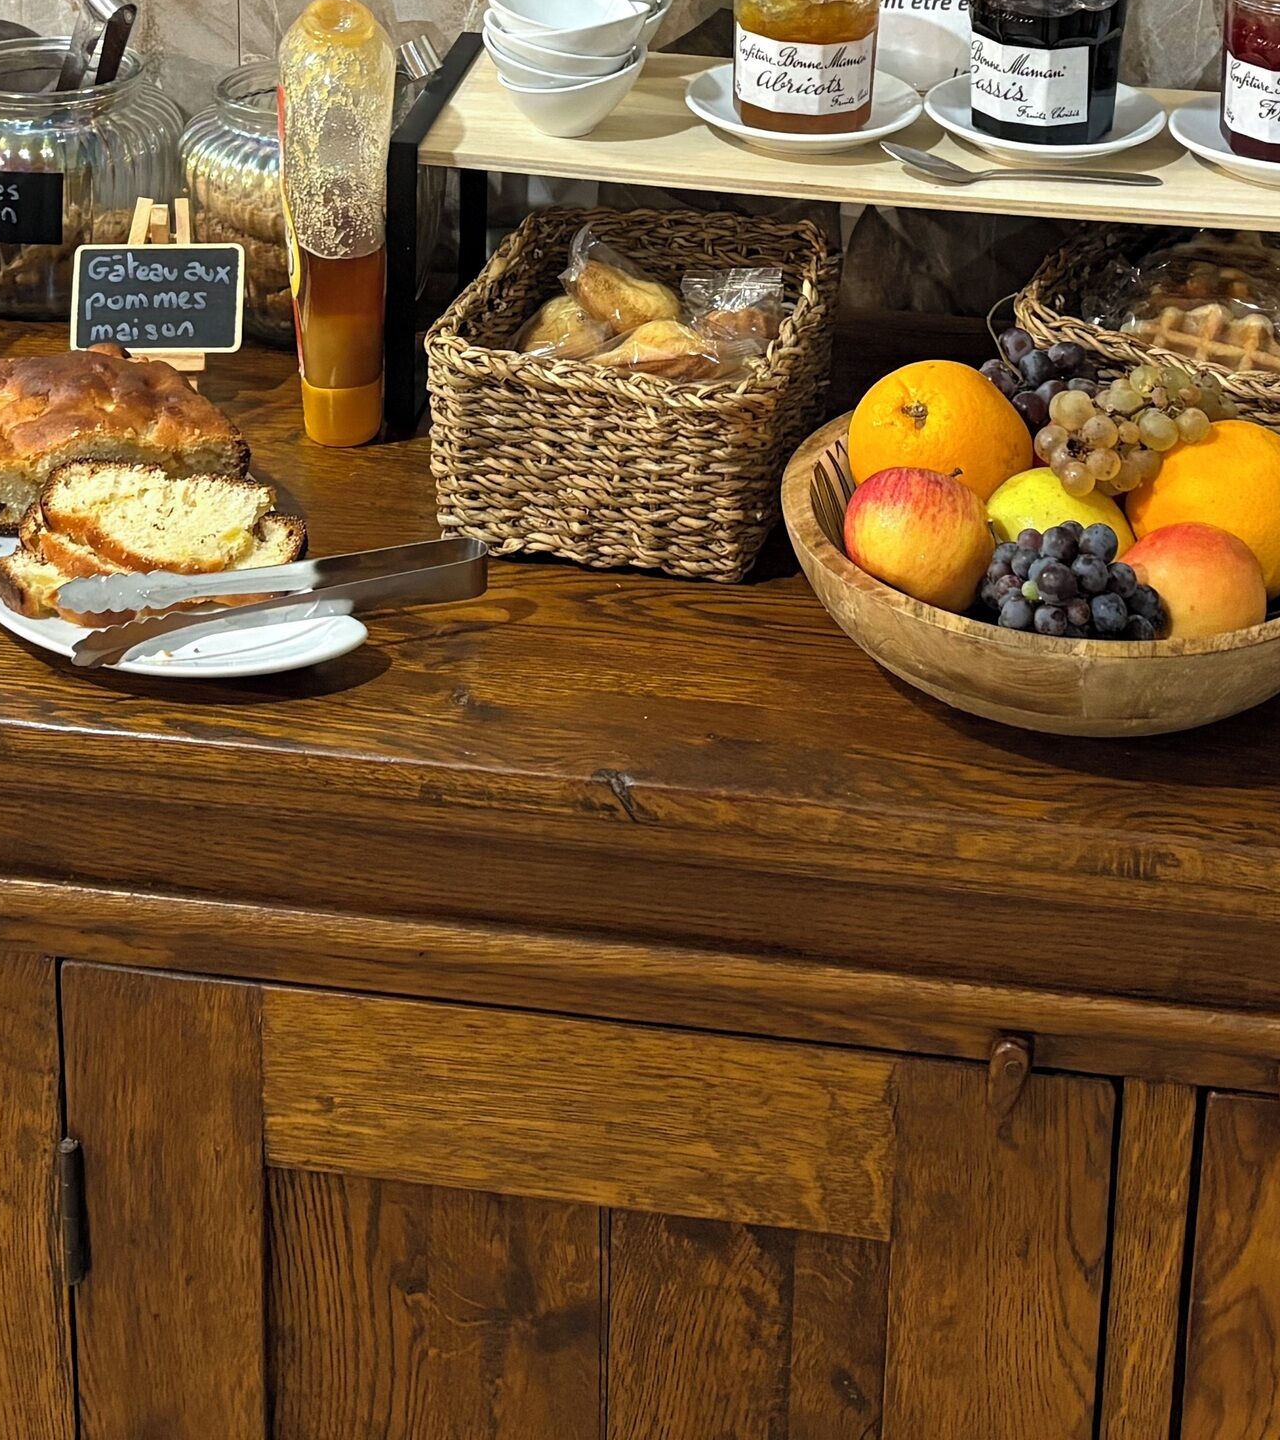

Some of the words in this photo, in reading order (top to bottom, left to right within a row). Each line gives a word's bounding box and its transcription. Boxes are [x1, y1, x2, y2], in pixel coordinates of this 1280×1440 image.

[777, 46, 822, 70] Bonne
[971, 40, 1001, 72] Bonne
[1003, 54, 1064, 78] Maman
[757, 70, 844, 95] Abricots
[971, 65, 1028, 102] Cassis
[88, 252, 178, 282] Gâteau
[184, 262, 230, 284] aux
[86, 292, 207, 320] pommes
[90, 318, 194, 341] maison
